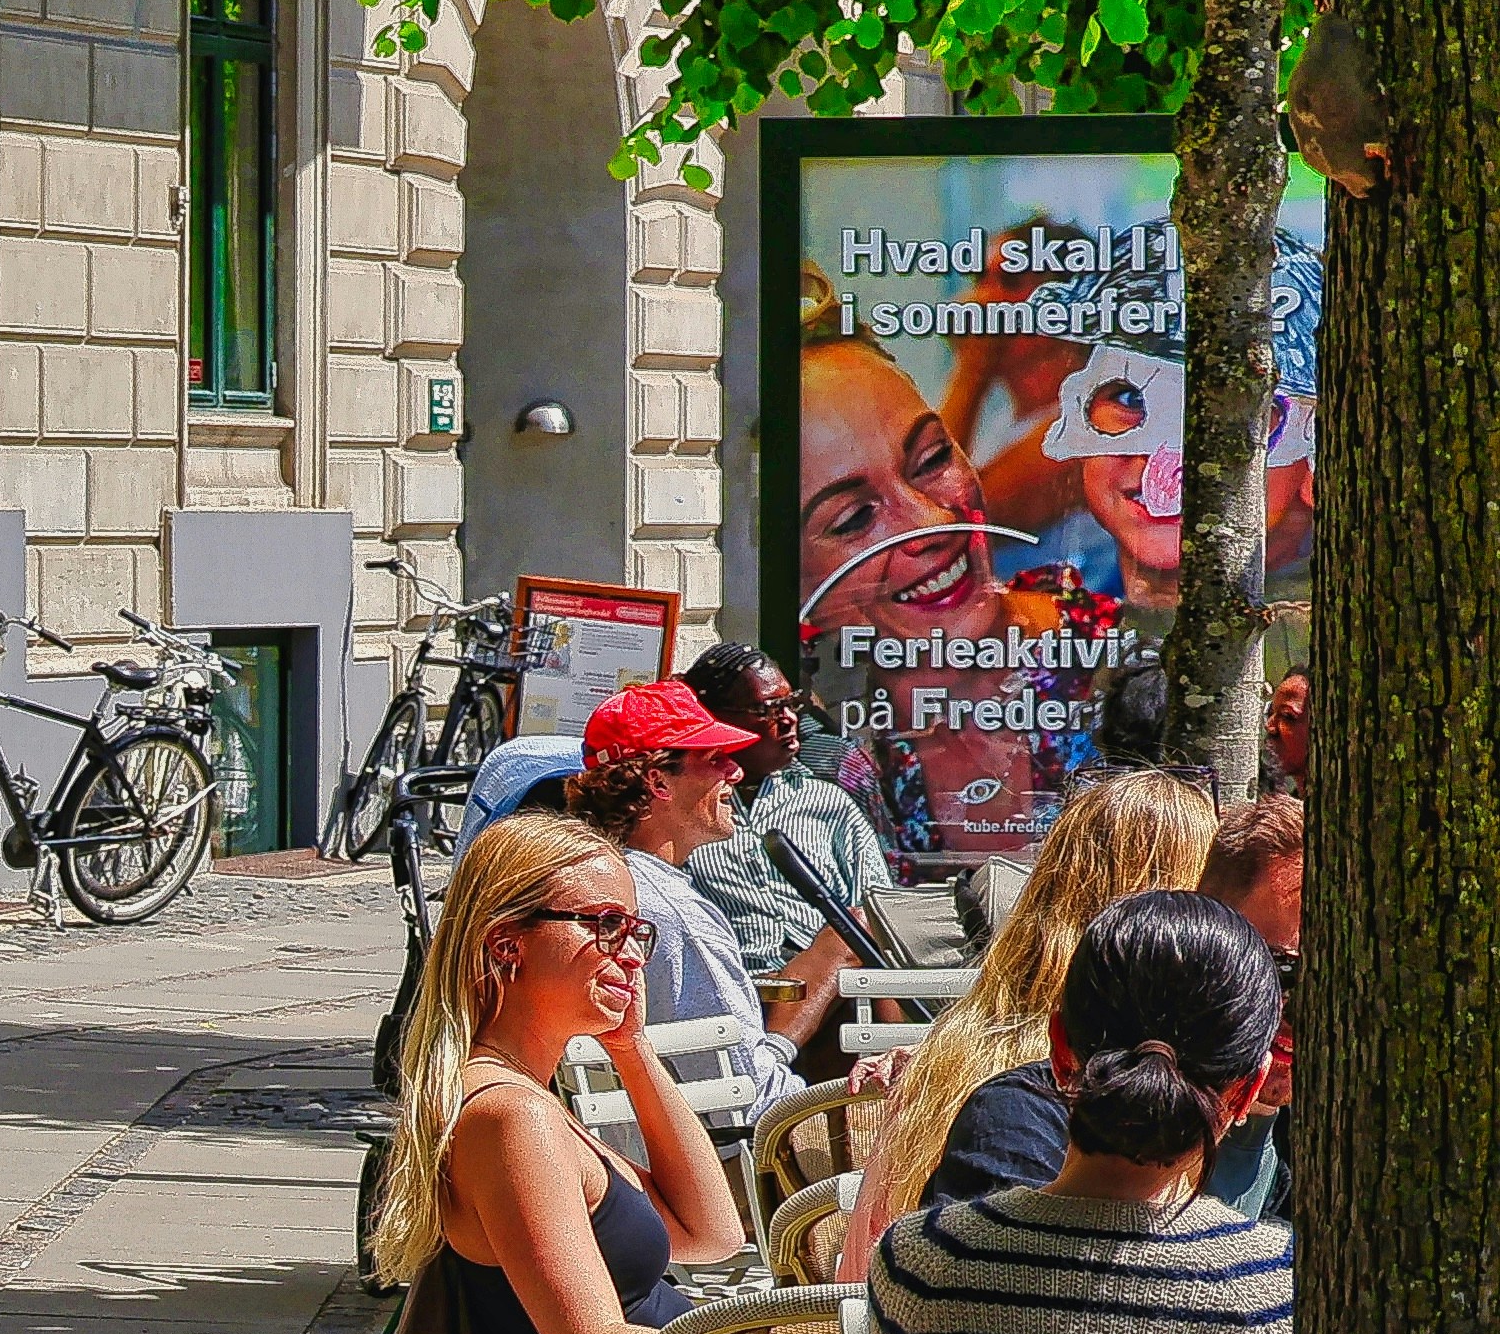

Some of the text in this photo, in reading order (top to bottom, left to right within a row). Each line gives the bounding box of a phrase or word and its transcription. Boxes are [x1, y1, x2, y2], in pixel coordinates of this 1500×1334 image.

[841, 226, 982, 272] Hvad
[1001, 226, 1111, 272] skal
[841, 293, 854, 334] i
[840, 688, 894, 738] på
